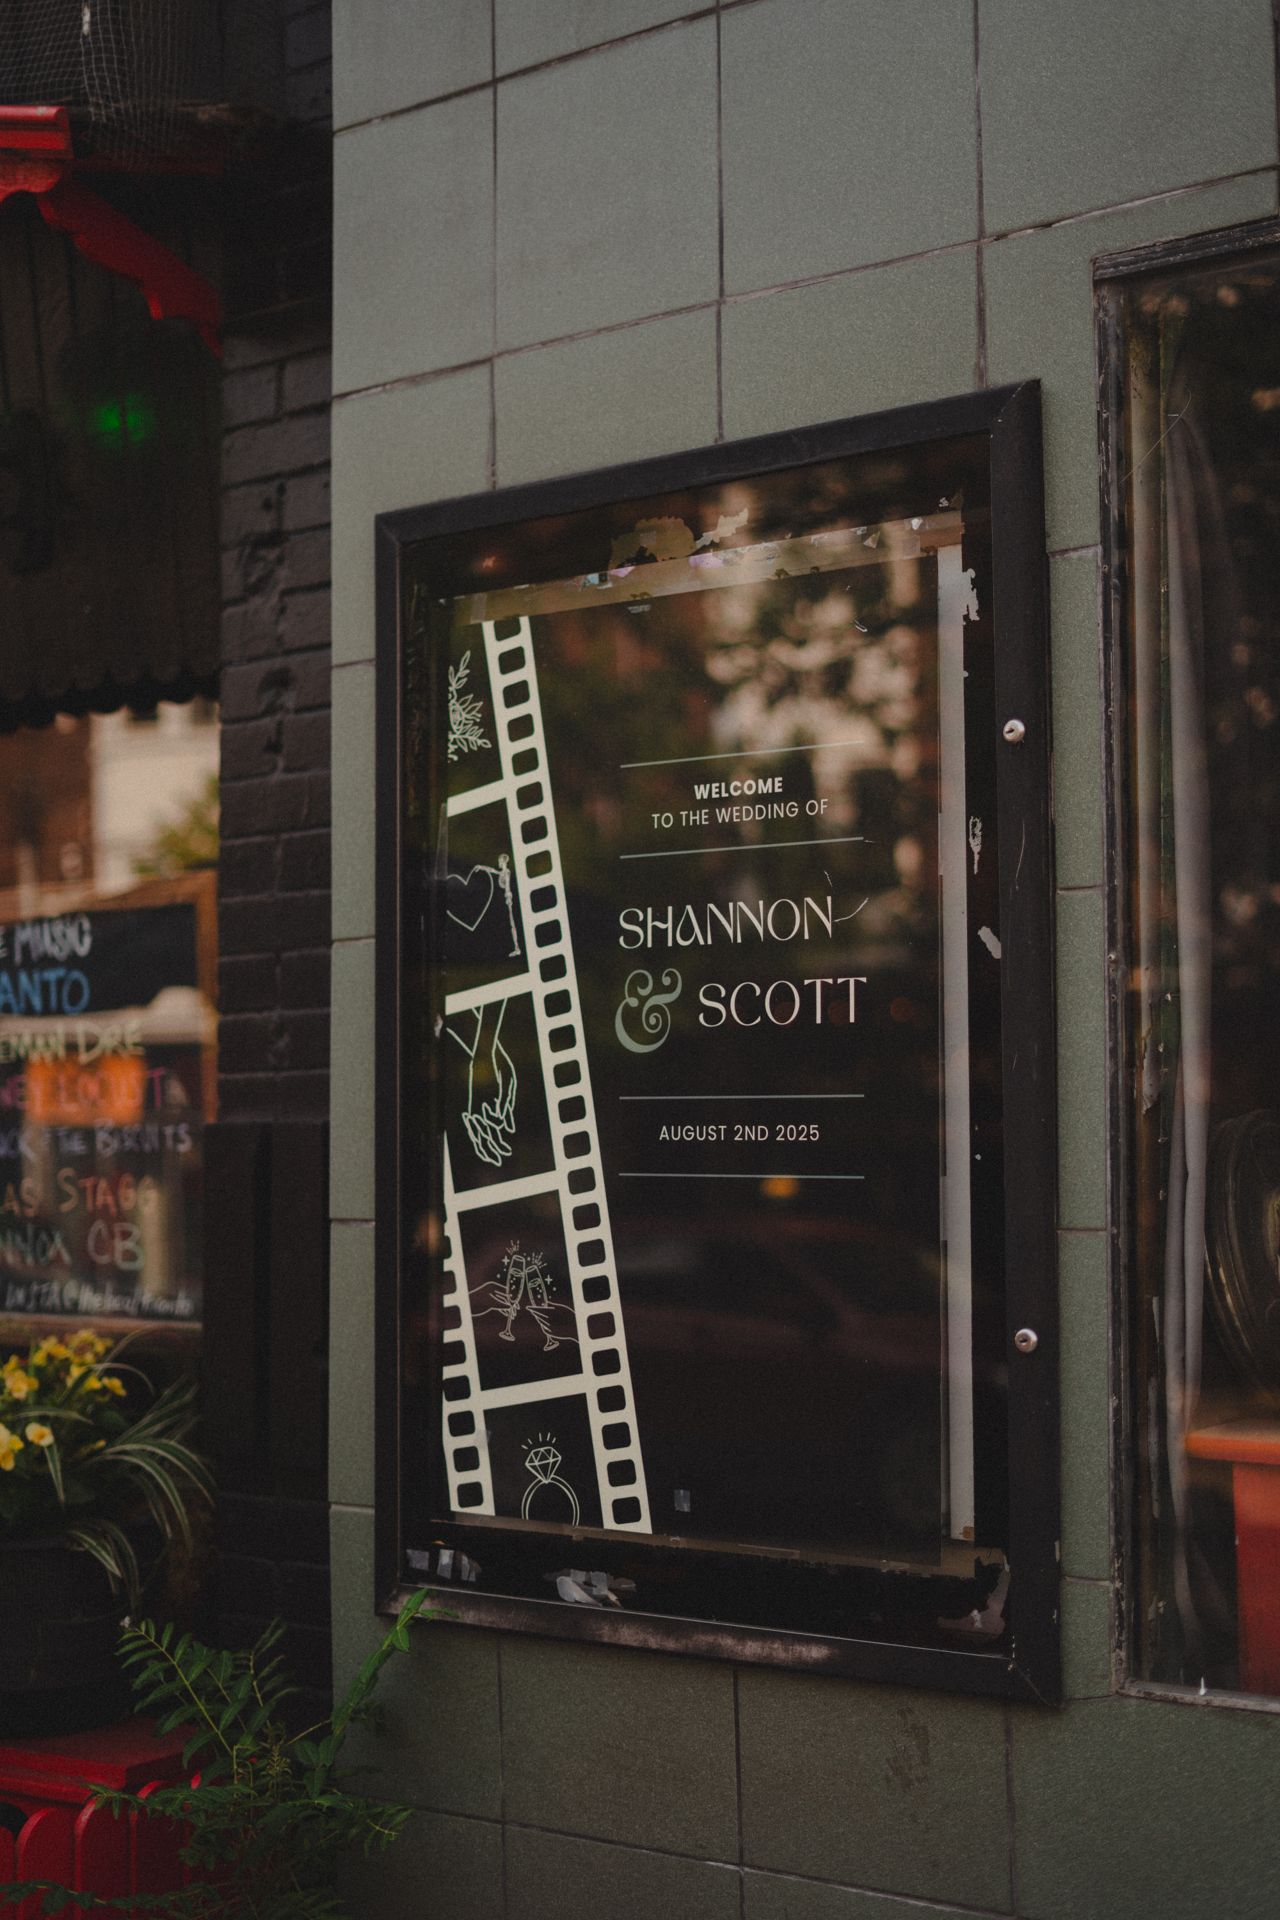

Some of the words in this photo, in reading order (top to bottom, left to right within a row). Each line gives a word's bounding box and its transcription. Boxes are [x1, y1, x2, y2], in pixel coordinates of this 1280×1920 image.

[694, 776, 783, 800] WELCOME
[651, 813, 674, 829] TO
[680, 809, 710, 826] THE
[715, 802, 799, 824] WEDDING
[805, 799, 829, 816] OF
[618, 896, 833, 949] SHANNON
[614, 967, 683, 1054] &
[698, 977, 867, 1028] SCOTT
[659, 1125, 727, 1141] AUGUST
[733, 1125, 769, 1141] 2ND
[775, 1125, 820, 1142] 2025
